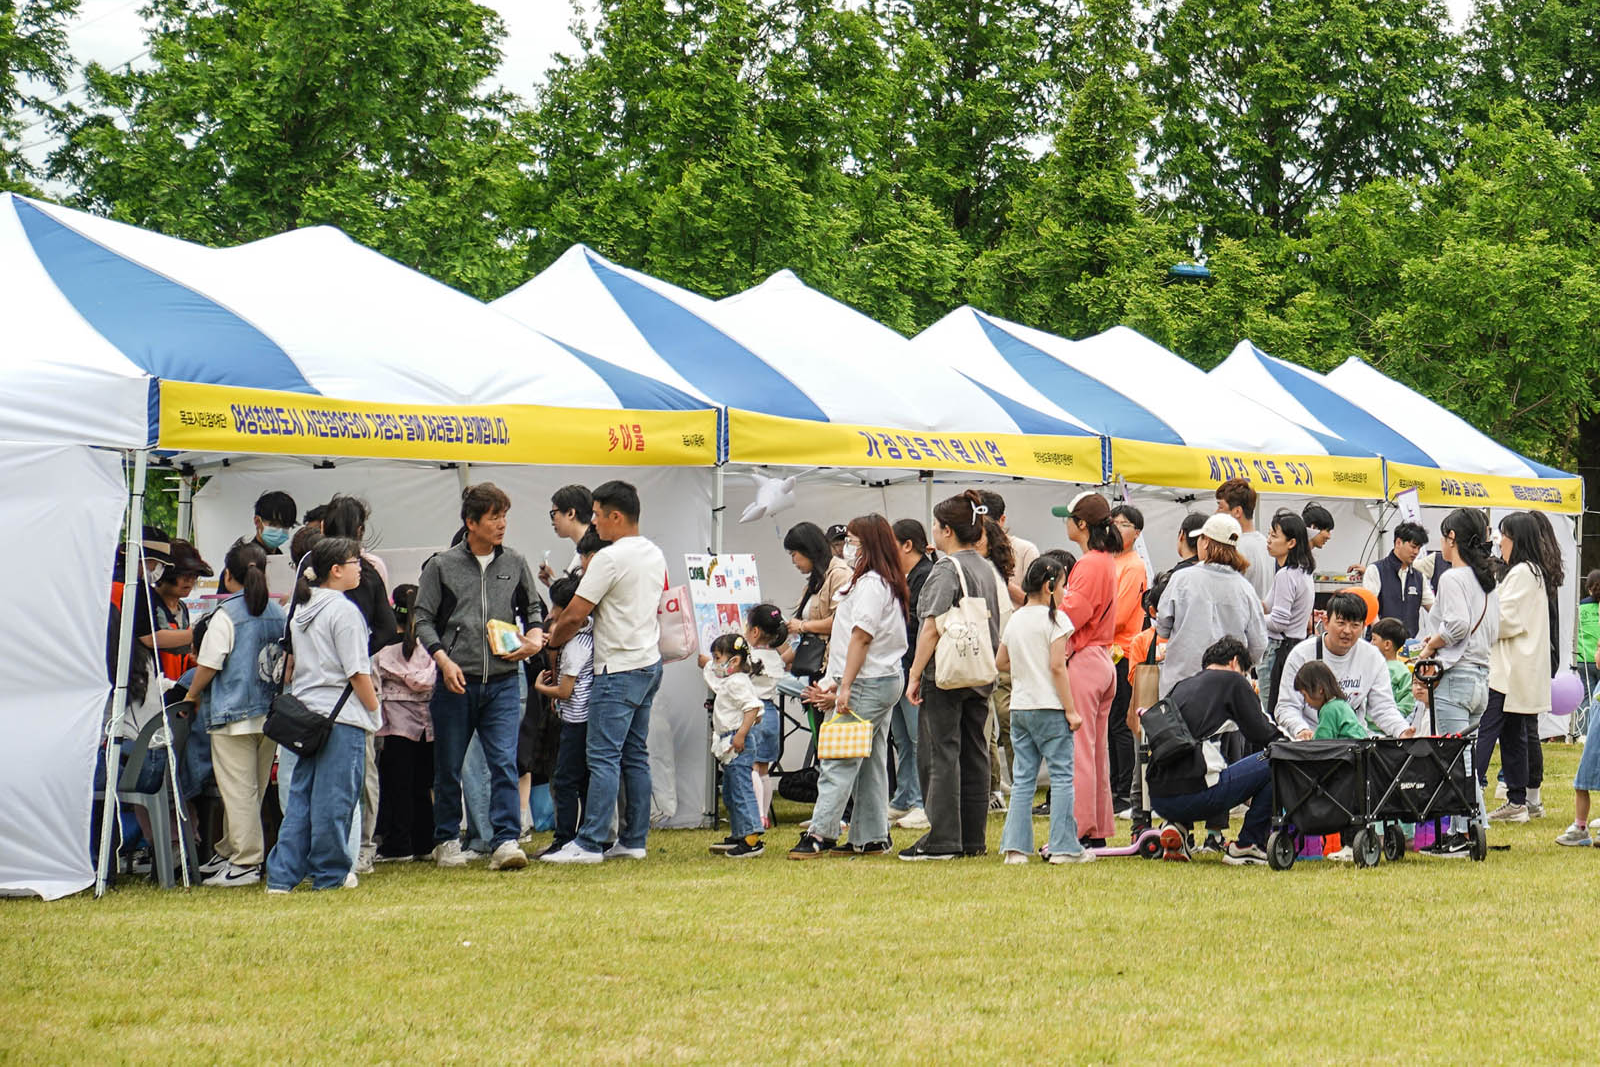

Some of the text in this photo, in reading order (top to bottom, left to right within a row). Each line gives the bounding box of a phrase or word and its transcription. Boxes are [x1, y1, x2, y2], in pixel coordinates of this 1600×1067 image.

[230, 403, 510, 445] 여성친화도시 시민참여단이 가정의 달에 여러분과 함께합니다.
[858, 431, 1007, 467] 가정양육지원사업
[1207, 455, 1251, 482] 세대간
[1253, 459, 1285, 485] 마음
[1285, 462, 1313, 487] 잇기
